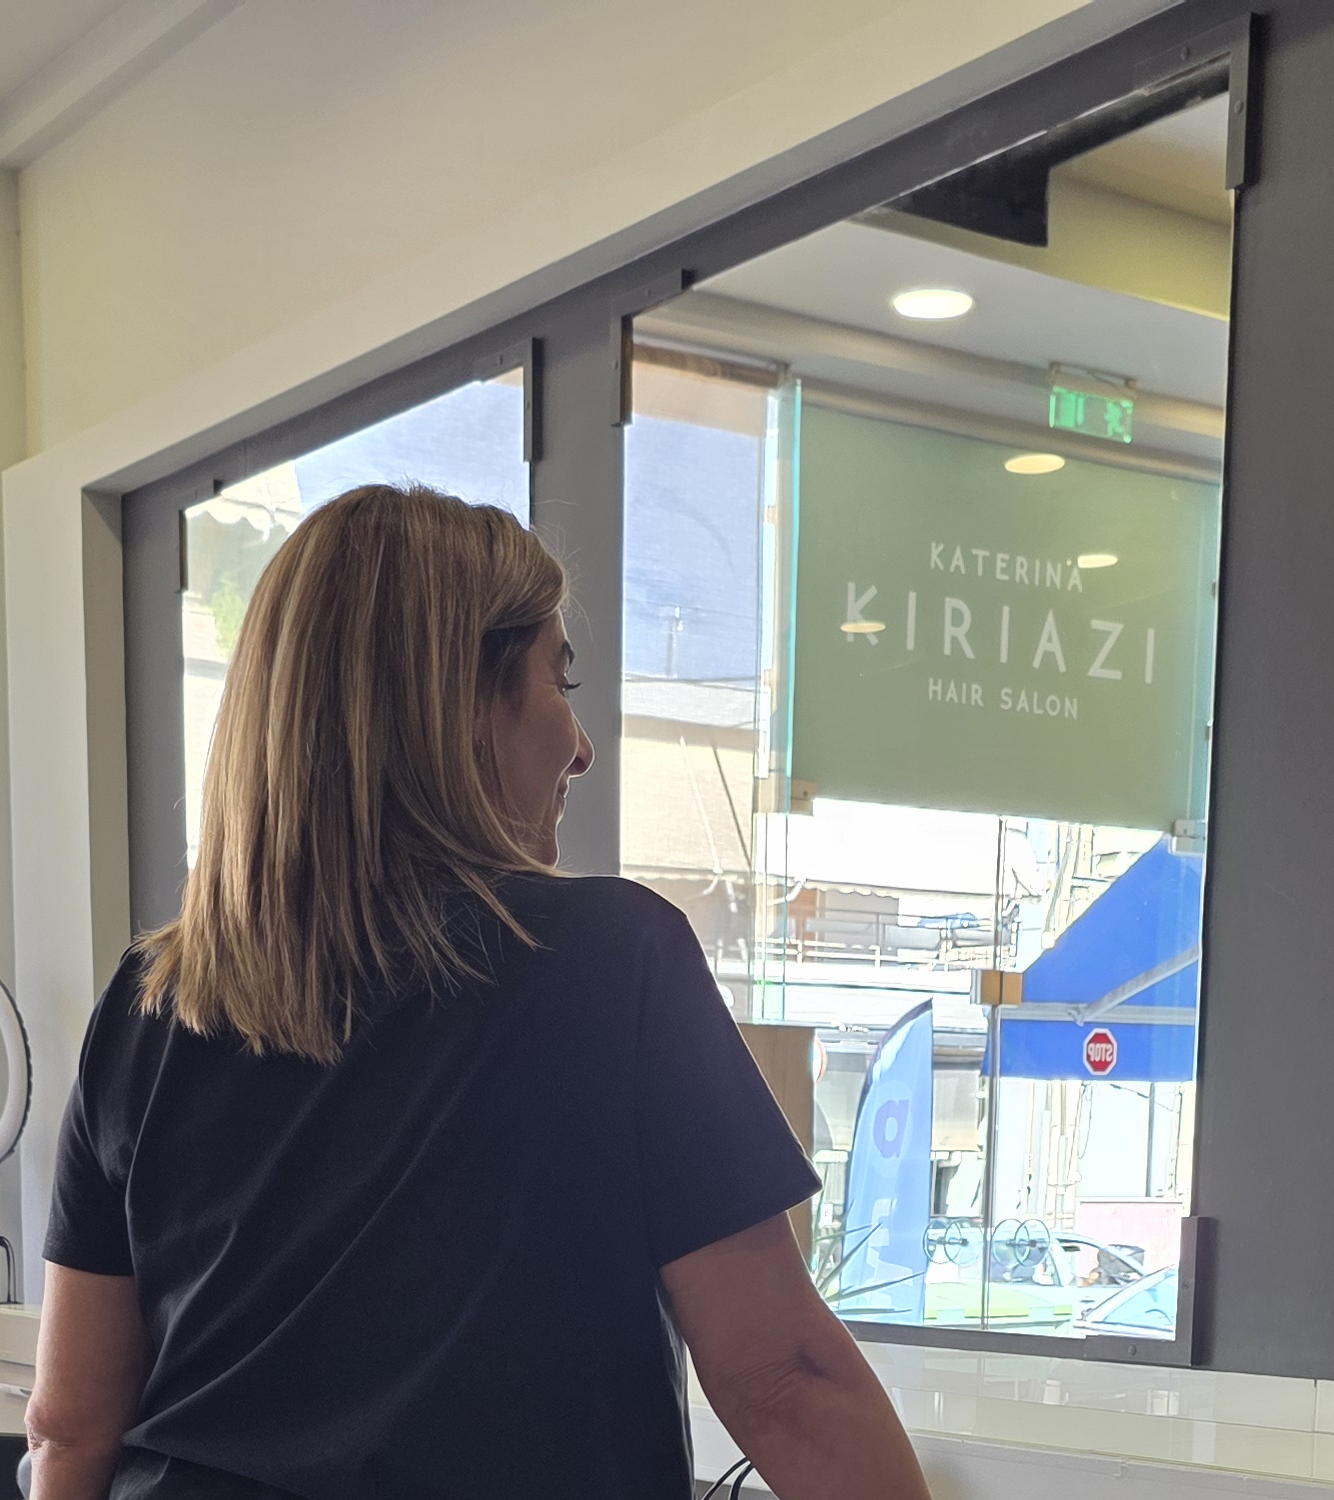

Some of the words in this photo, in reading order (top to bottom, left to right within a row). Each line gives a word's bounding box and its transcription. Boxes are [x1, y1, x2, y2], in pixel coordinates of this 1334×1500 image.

[929, 541, 1083, 593] KATERINA
[845, 581, 1156, 684] KIRIAZI
[928, 677, 985, 708] HAIR
[1000, 686, 1079, 720] SALON
